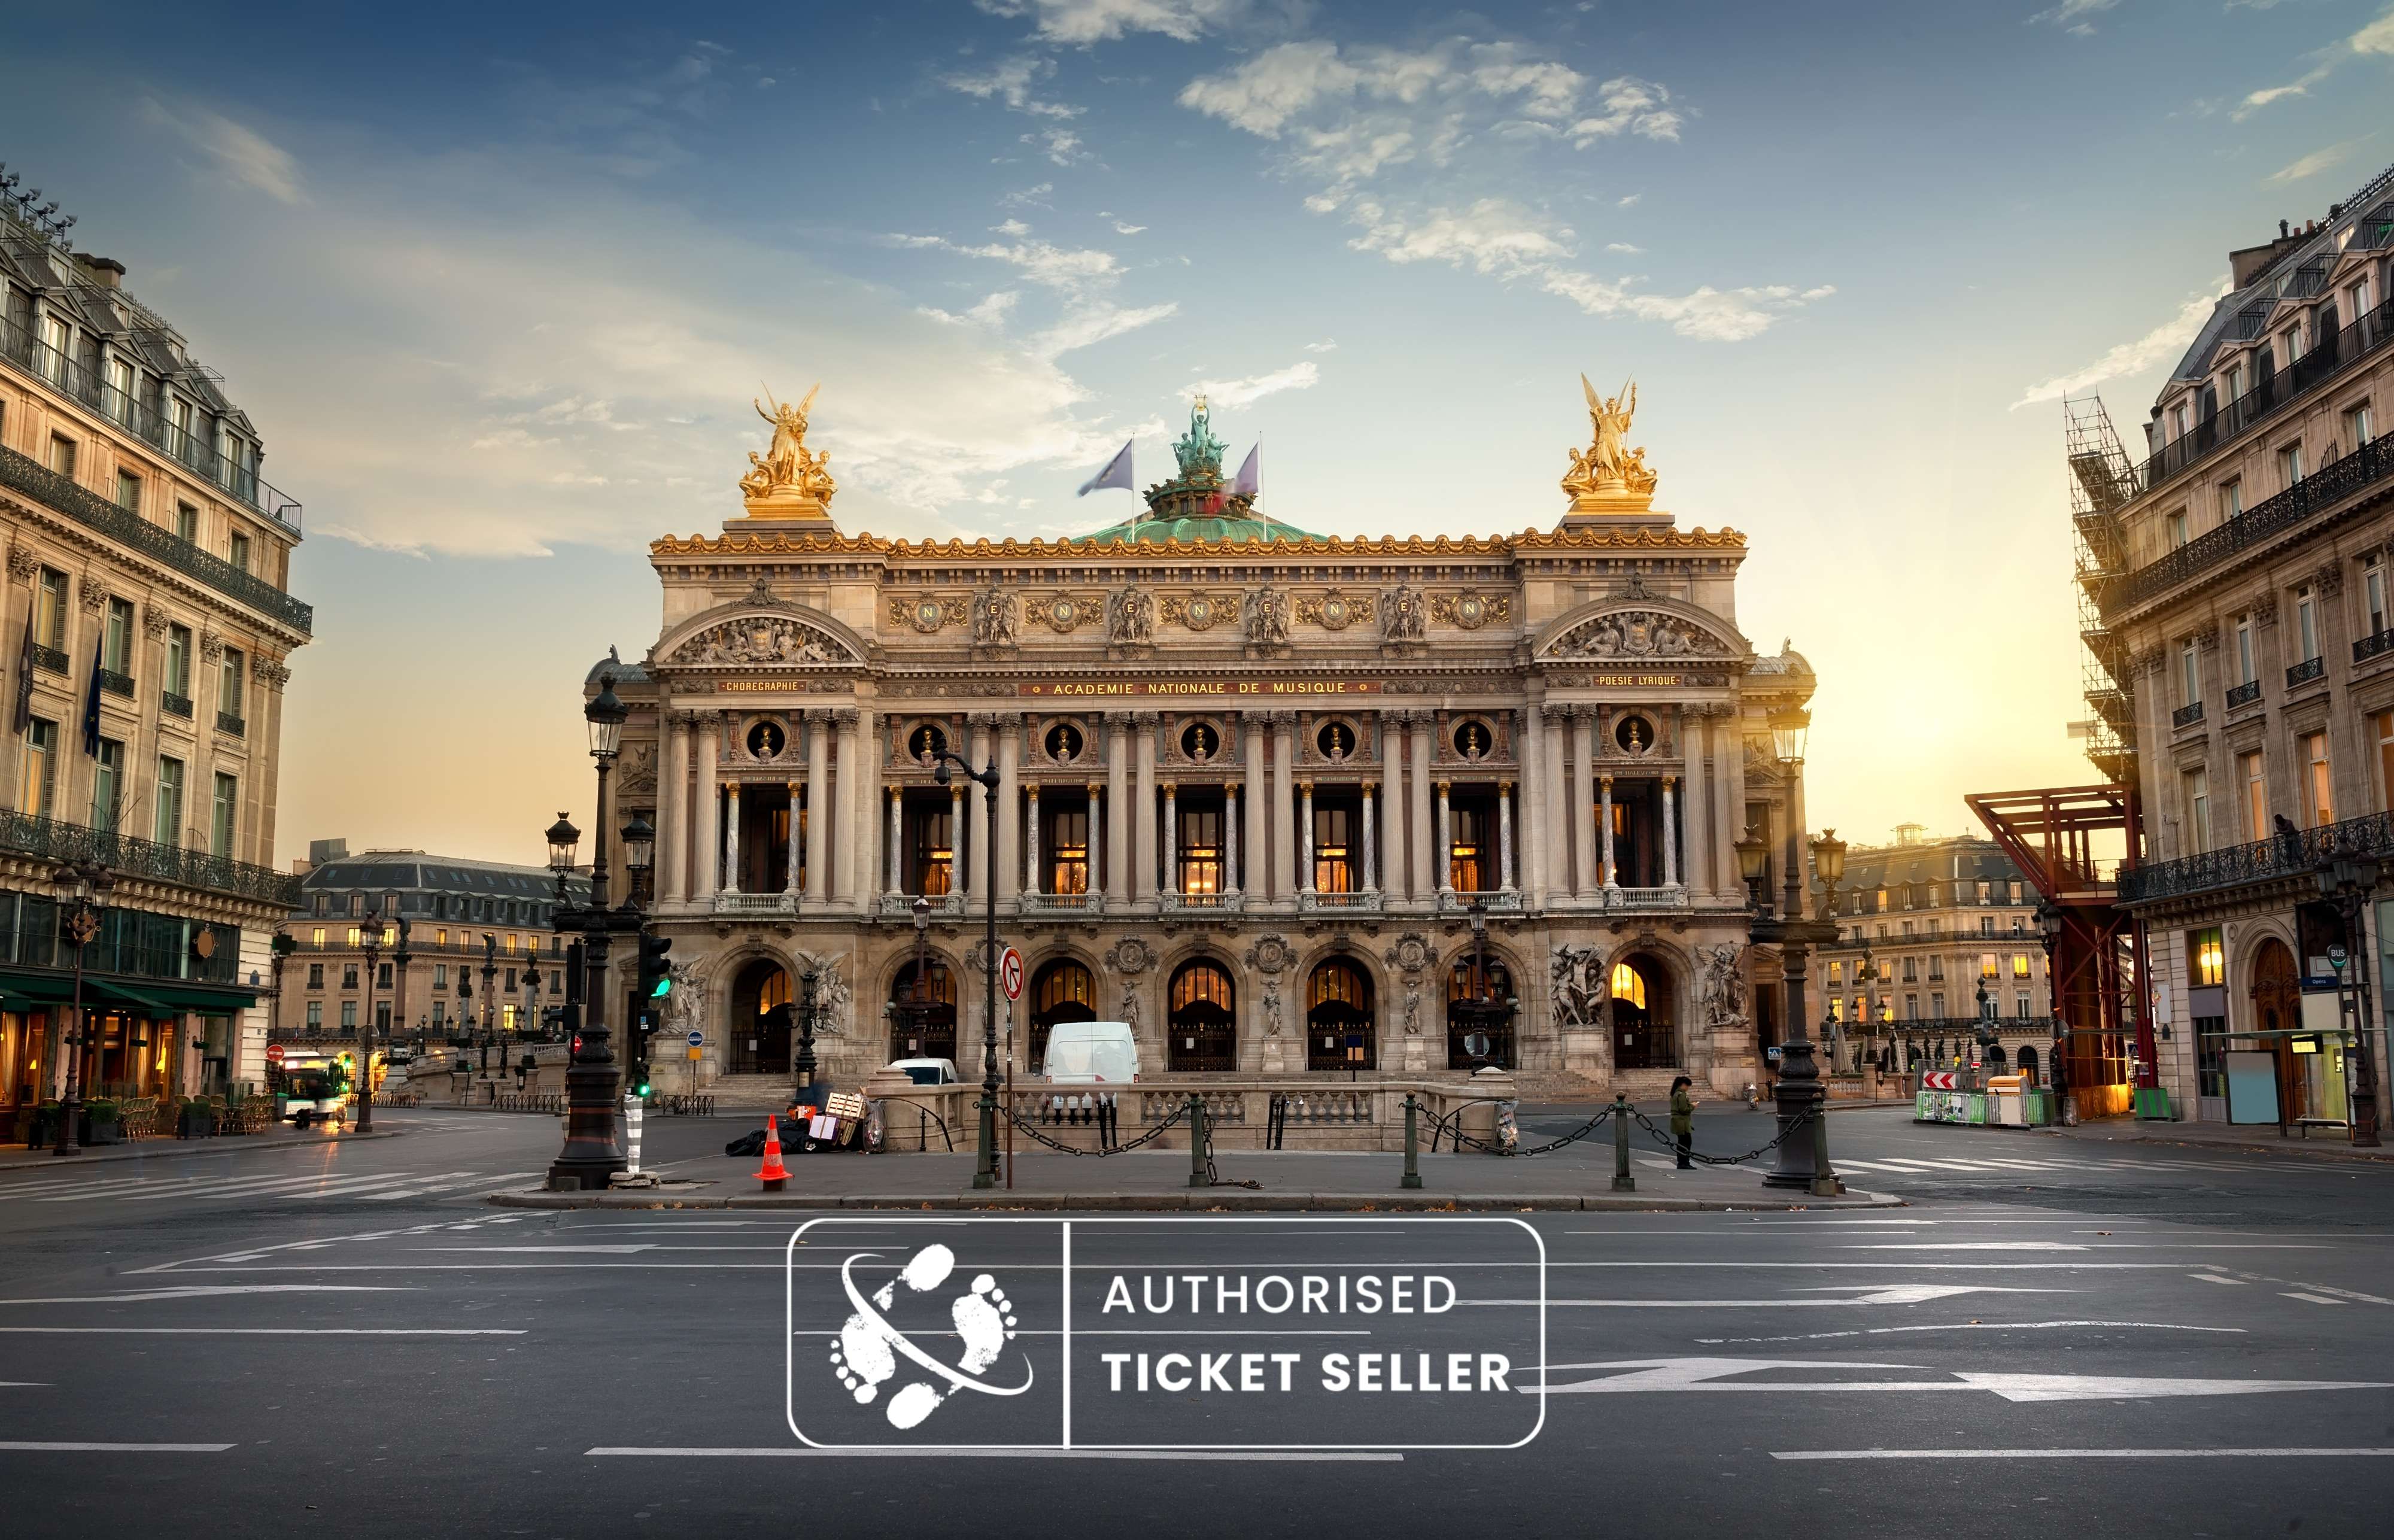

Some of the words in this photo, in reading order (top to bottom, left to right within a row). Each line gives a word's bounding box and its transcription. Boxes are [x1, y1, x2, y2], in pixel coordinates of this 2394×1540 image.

[991, 605, 997, 613] E
[1059, 606, 1068, 616] N
[1127, 604, 1134, 612] E
[1195, 606, 1203, 615] N
[1264, 603, 1271, 612] E
[1330, 605, 1339, 614] N
[1401, 603, 1408, 611] E
[1466, 604, 1475, 613] N
[923, 608, 932, 618] N
[1600, 676, 1633, 685] POESIE
[1639, 676, 1676, 685] LYRIQUE
[727, 682, 798, 691] CHOREGRAPHIE
[1053, 684, 1134, 694] ACADEMIE
[1148, 684, 1225, 694] NATIONALE
[1239, 683, 1259, 693] DE
[1273, 682, 1345, 693] MUSIQUE
